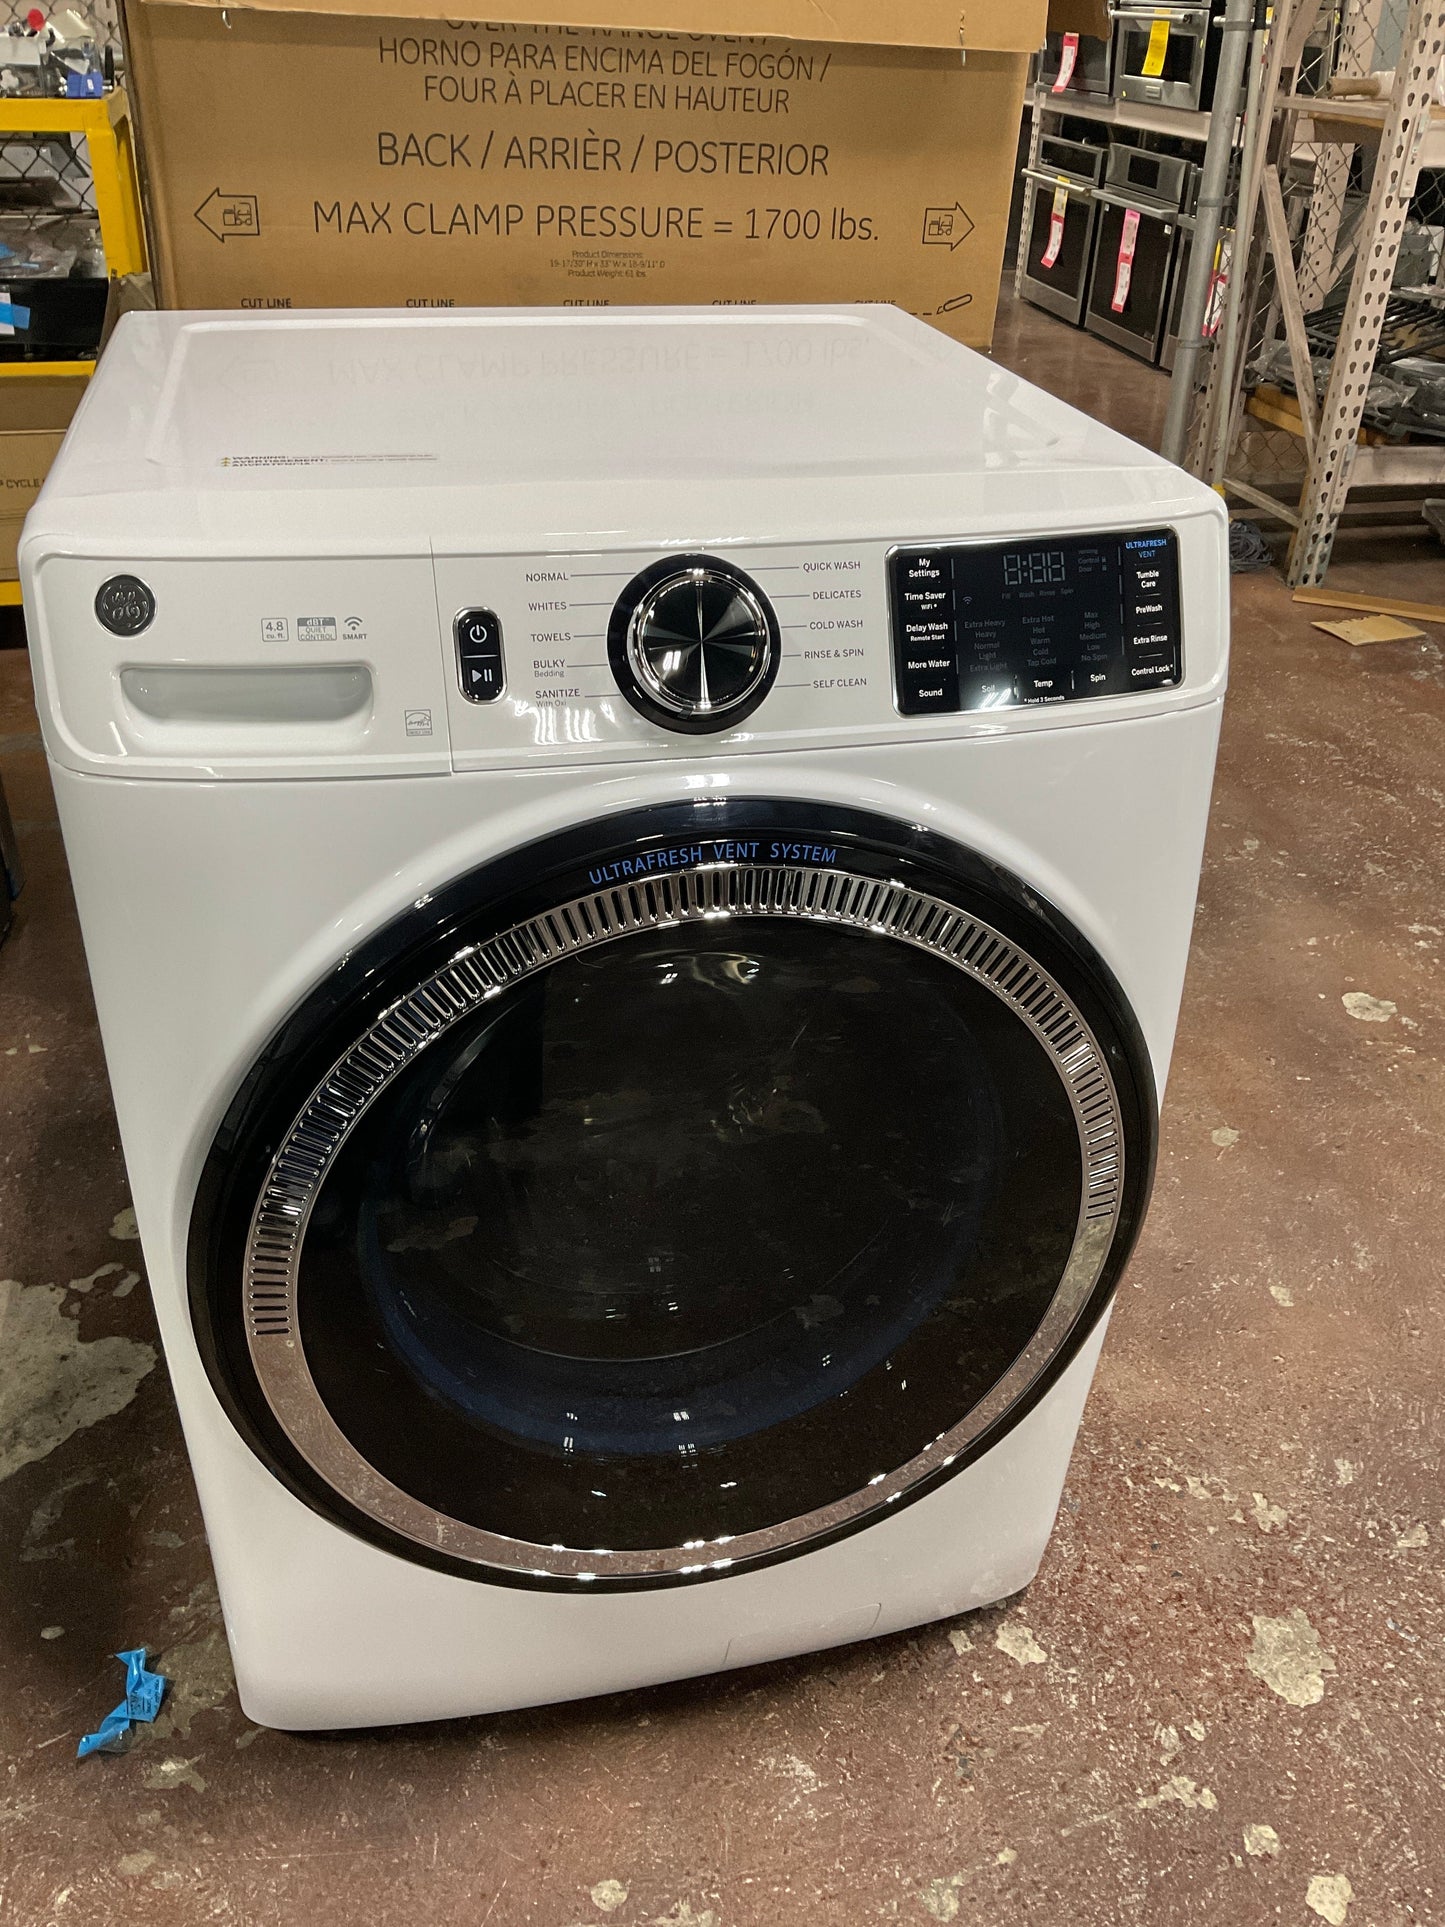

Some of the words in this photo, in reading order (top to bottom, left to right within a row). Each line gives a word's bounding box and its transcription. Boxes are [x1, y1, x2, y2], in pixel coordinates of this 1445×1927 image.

[379, 36, 481, 67] HORNO
[490, 42, 557, 70] PARA
[565, 45, 664, 74] ENCIMA
[672, 50, 718, 77] DEL
[725, 47, 814, 80] FOGÓN
[819, 53, 832, 83] /
[424, 75, 497, 104] FOUR
[504, 71, 522, 105] À
[530, 79, 626, 108] PLACER
[634, 83, 666, 109] EN
[675, 85, 789, 114] HAUTEUR
[378, 131, 472, 168] BACK
[480, 130, 494, 169] /
[503, 128, 622, 171] ARRIÈR
[630, 134, 645, 173] /
[655, 140, 829, 176] POSTERIOR
[313, 201, 392, 234] MAX
[403, 202, 524, 236] CLAMP
[536, 205, 704, 239] PRESSURE
[713, 221, 733, 233] =
[745, 208, 821, 240] 1700
[831, 207, 879, 241] lbs.
[572, 250, 600, 259] Product
[567, 269, 596, 278] Product
[240, 298, 263, 308] CUT
[267, 298, 292, 308] LINE
[406, 298, 428, 308] CUT
[430, 298, 455, 308] LINE
[6, 478, 40, 489] CYCLE
[1125, 538, 1167, 549] ULTRAFRESH
[1138, 550, 1156, 558] VENT
[803, 562, 833, 573] QUICK
[833, 561, 861, 570] WASH
[918, 558, 931, 568] My
[525, 572, 569, 582] NORMAL
[908, 568, 940, 578] Settings
[1136, 570, 1160, 579] Tumble
[1141, 580, 1156, 588] Care
[812, 589, 862, 600] DELICATES
[904, 592, 924, 601] Time
[924, 591, 946, 600] Saver
[528, 601, 567, 612] WHITES
[1135, 604, 1163, 614] PreWash
[809, 621, 835, 630] COLD
[837, 619, 864, 629] WASH
[964, 620, 983, 629] Extra
[984, 618, 1006, 628] Heavy
[1022, 616, 1040, 624] Extra
[1041, 615, 1055, 623] Hot
[265, 621, 284, 632] 4.8
[305, 626, 327, 634] QUIET
[906, 623, 927, 633] Delay
[927, 622, 949, 631] Wash
[1032, 626, 1046, 634] Hot
[300, 633, 334, 641] CONTROL
[530, 632, 571, 642] TOWELS
[910, 634, 931, 642] Remote
[974, 630, 997, 639] Heavy
[1133, 636, 1150, 645] Extra
[1150, 634, 1168, 643] Rinse
[974, 641, 1000, 650] Normal
[1030, 637, 1050, 645] Warm
[804, 649, 832, 659] RINSE
[833, 649, 841, 658] &
[842, 648, 864, 657] SPIN
[978, 651, 997, 660] Light
[1032, 648, 1049, 656] Cold
[1027, 659, 1040, 667] Tap
[1040, 657, 1057, 665] Cold
[1092, 653, 1108, 662] Spin
[533, 659, 566, 669] BULKY
[907, 661, 927, 670] More
[927, 659, 950, 668] Water
[969, 664, 989, 673] Extra
[989, 661, 1008, 671] Light
[534, 669, 565, 678] Bedding
[1131, 666, 1154, 676] Control
[1155, 665, 1170, 674] Lock
[1090, 673, 1106, 683] Spin
[813, 679, 836, 689] SELF
[836, 678, 867, 688] CLEAN
[981, 684, 996, 693] Soil
[1033, 679, 1054, 688] Temp
[535, 688, 581, 699] SANITIZE
[918, 688, 943, 697] Sound
[536, 699, 553, 708] With
[554, 699, 567, 707] Oxi
[588, 846, 702, 885] ULTRAFRESH
[713, 842, 760, 860] VENT
[770, 842, 837, 863] SYSTEM
